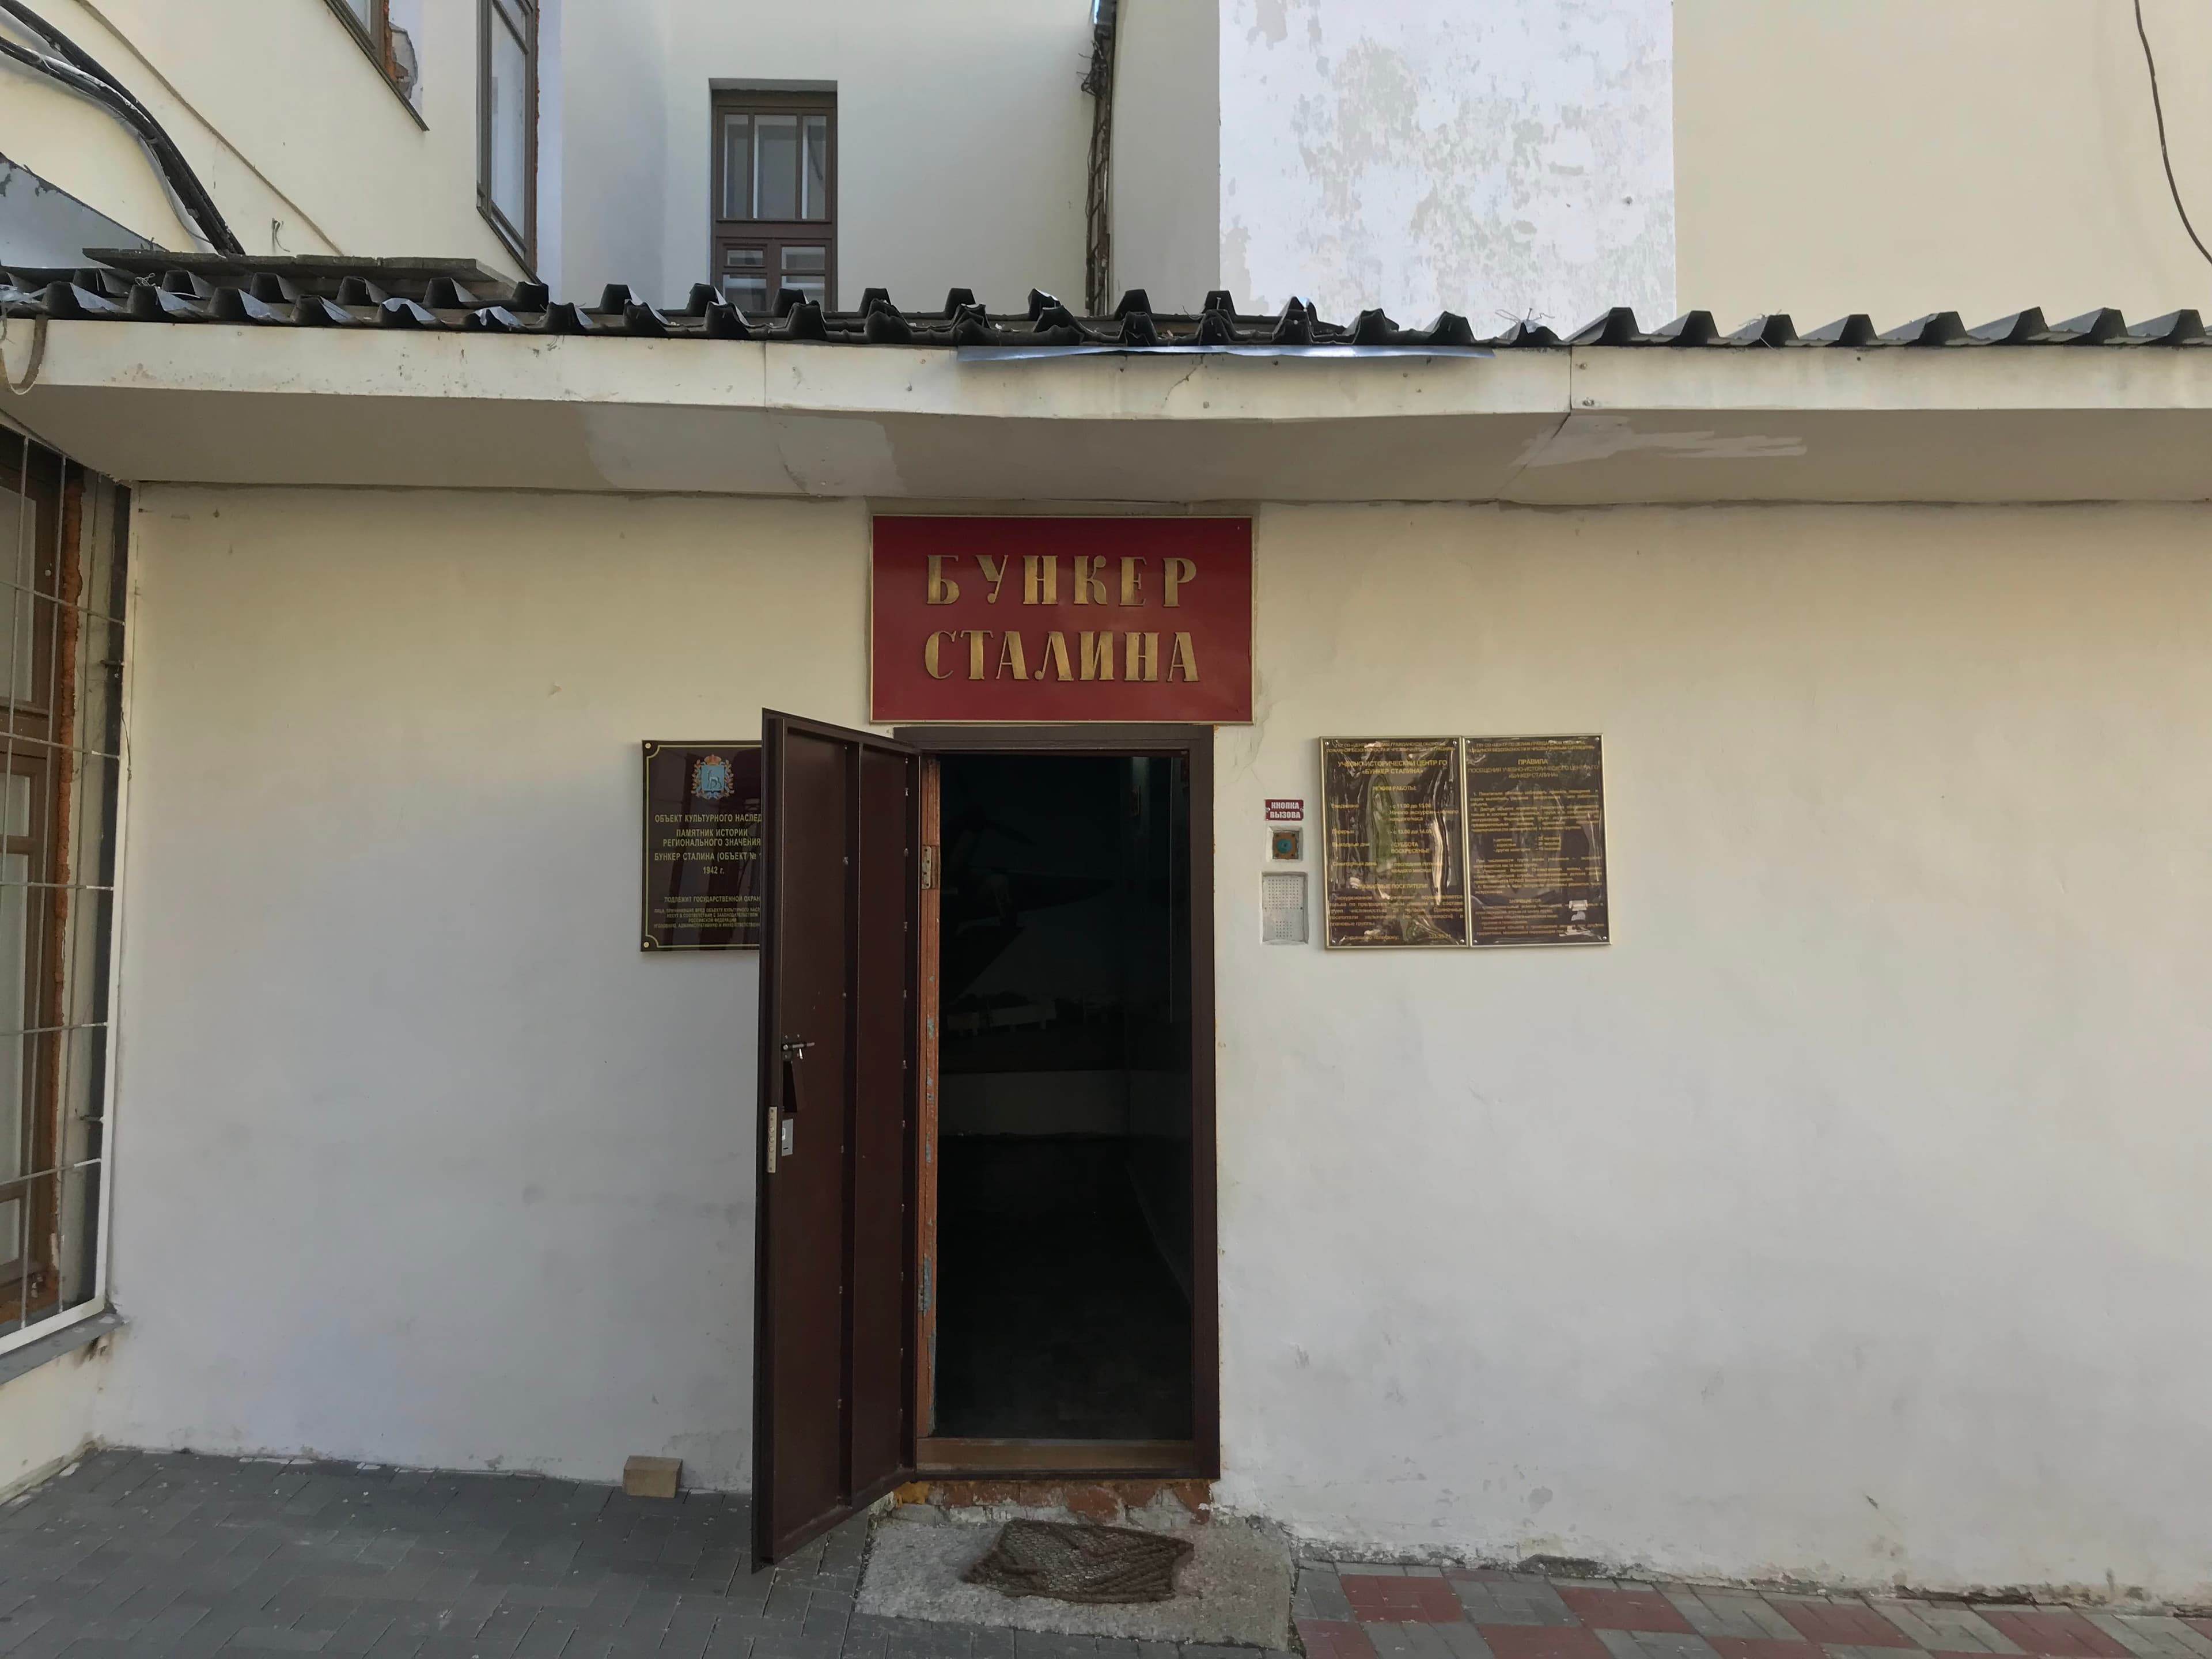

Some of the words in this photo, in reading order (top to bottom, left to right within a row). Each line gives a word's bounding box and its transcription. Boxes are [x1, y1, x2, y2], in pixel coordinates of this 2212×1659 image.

[926, 555, 1196, 607] БУНКЕР
[925, 630, 1200, 682] СТАЛИНА
[654, 814, 683, 823] ОБЪЕКТ
[684, 814, 733, 823] КУЛЬТУРНОГО
[676, 829, 714, 837] ПАМЯТНИК
[715, 828, 748, 836] ИСТОРИИ
[663, 838, 723, 847] РЕГИОНАЛЬНОГО
[725, 838, 761, 846] ЗНАЧЕНИЯ
[654, 853, 680, 861] БУНКЕР
[683, 852, 715, 861] СТАЛИНА
[717, 852, 747, 862] (ОБЪЕКТ
[703, 866, 718, 874] 1942
